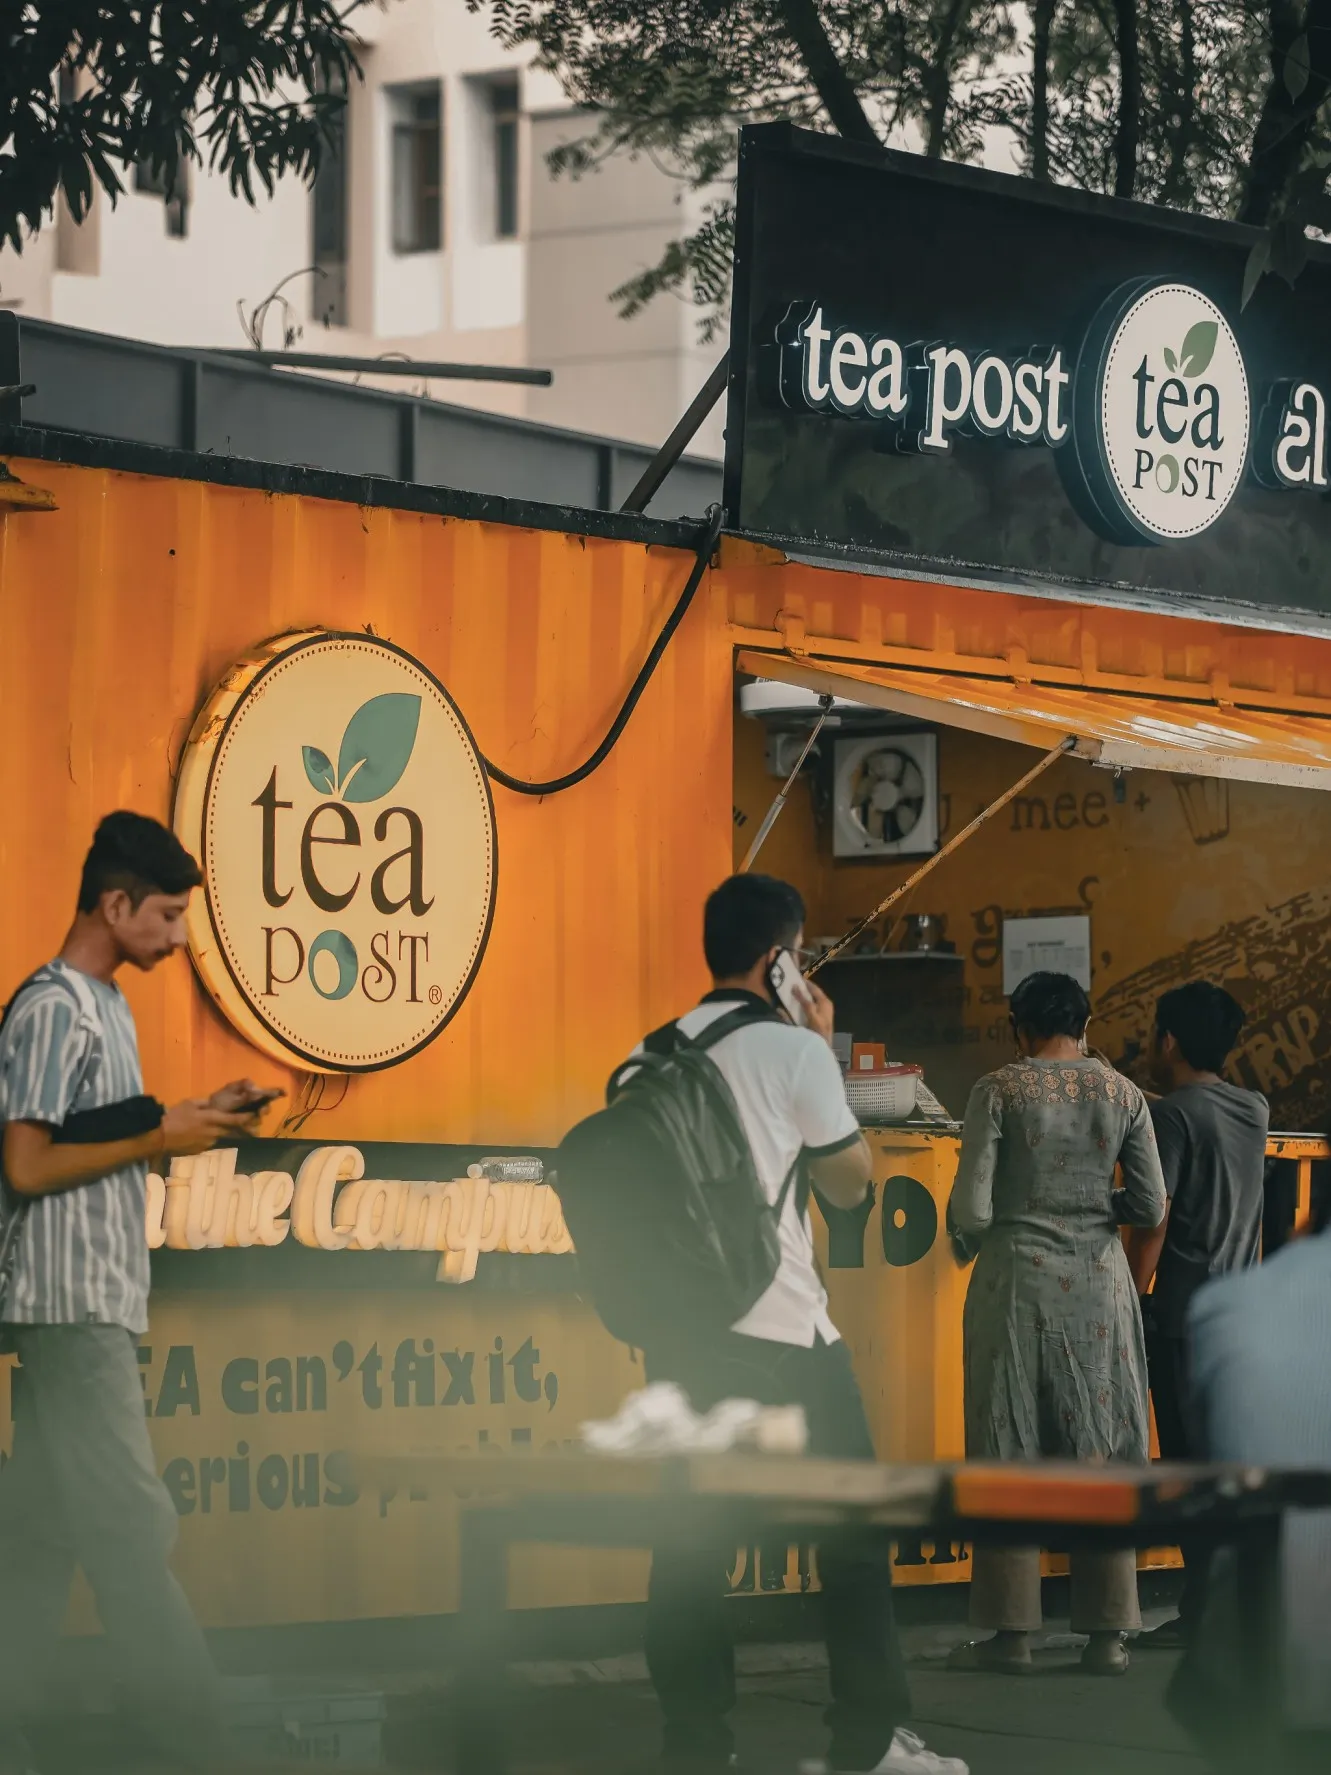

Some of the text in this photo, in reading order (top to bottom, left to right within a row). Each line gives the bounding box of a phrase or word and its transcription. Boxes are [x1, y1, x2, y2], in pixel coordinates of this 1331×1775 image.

[803, 307, 1068, 448] tea post
[1132, 354, 1224, 449] tea
[1132, 449, 1222, 500] POST
[251, 765, 434, 917] tea
[1010, 791, 1110, 832] mee
[163, 1147, 294, 1249] the
[292, 1146, 575, 1284] Campus
[138, 1335, 558, 1418] EA can't fix it,
[162, 1441, 360, 1517] erious
